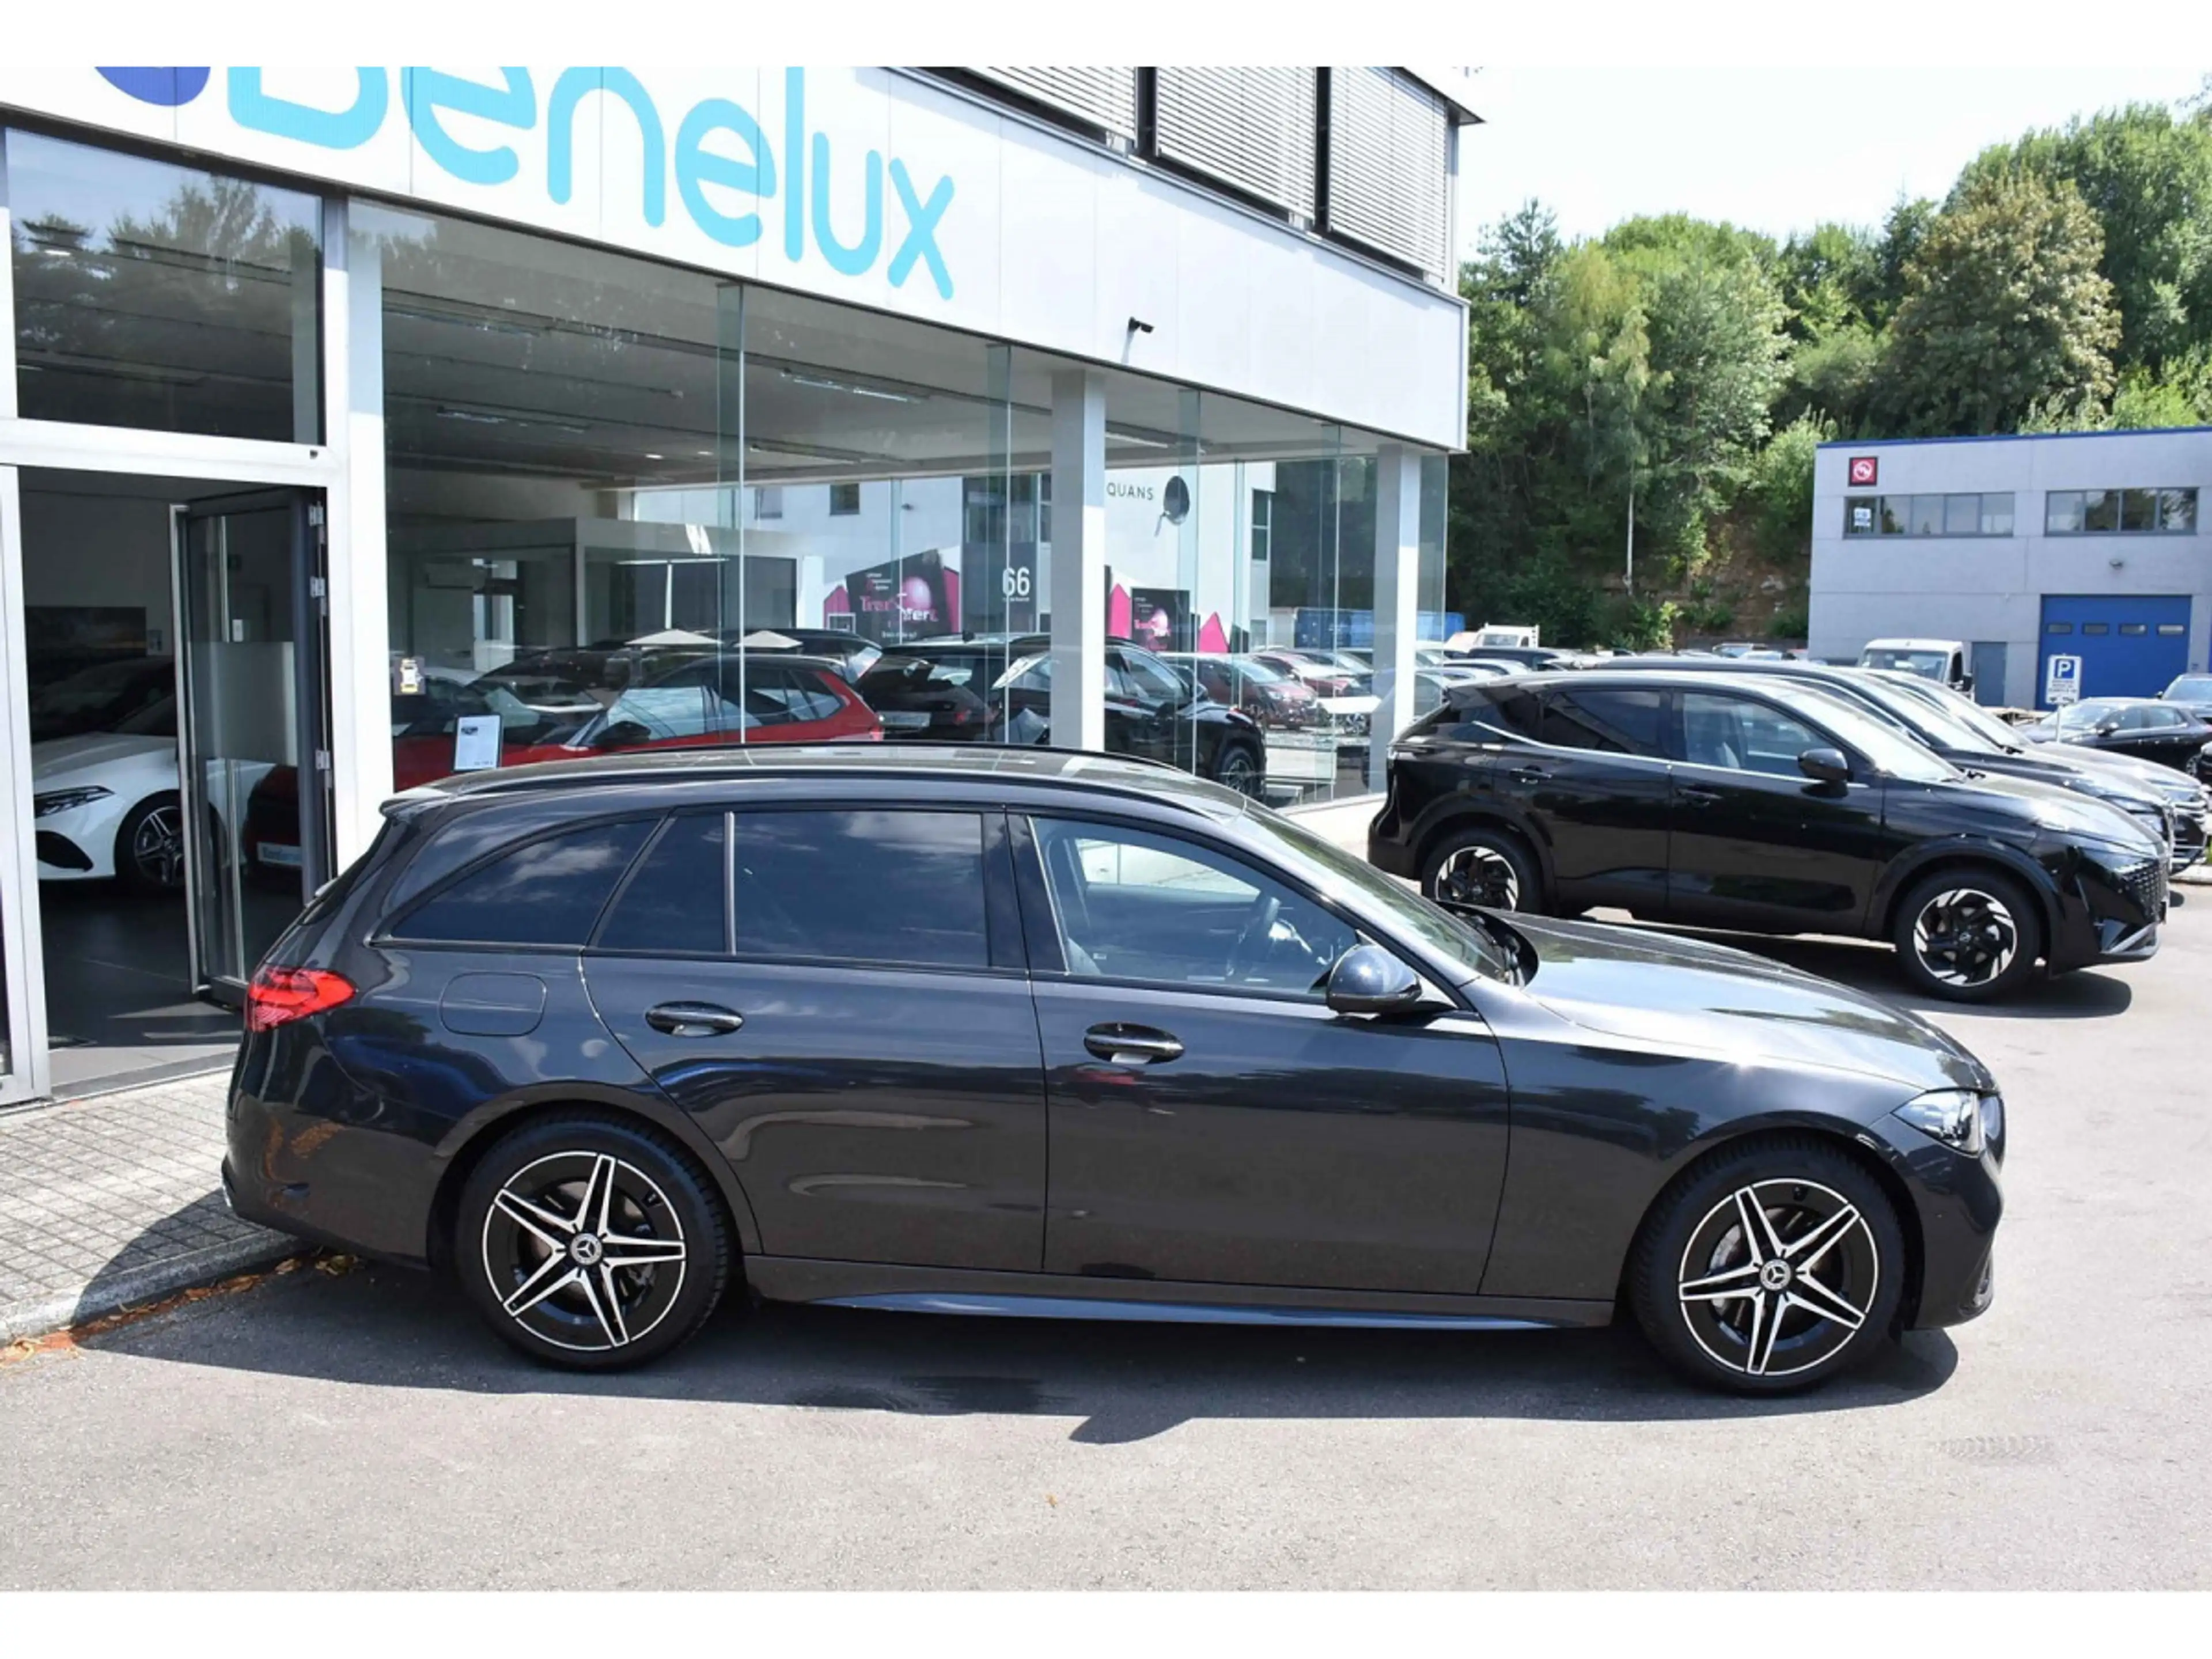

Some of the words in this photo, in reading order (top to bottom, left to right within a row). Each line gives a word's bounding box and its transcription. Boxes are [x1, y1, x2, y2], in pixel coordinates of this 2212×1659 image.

[1107, 482, 1154, 501] QUANS
[1003, 567, 1030, 596] 66
[2058, 661, 2071, 677] P
